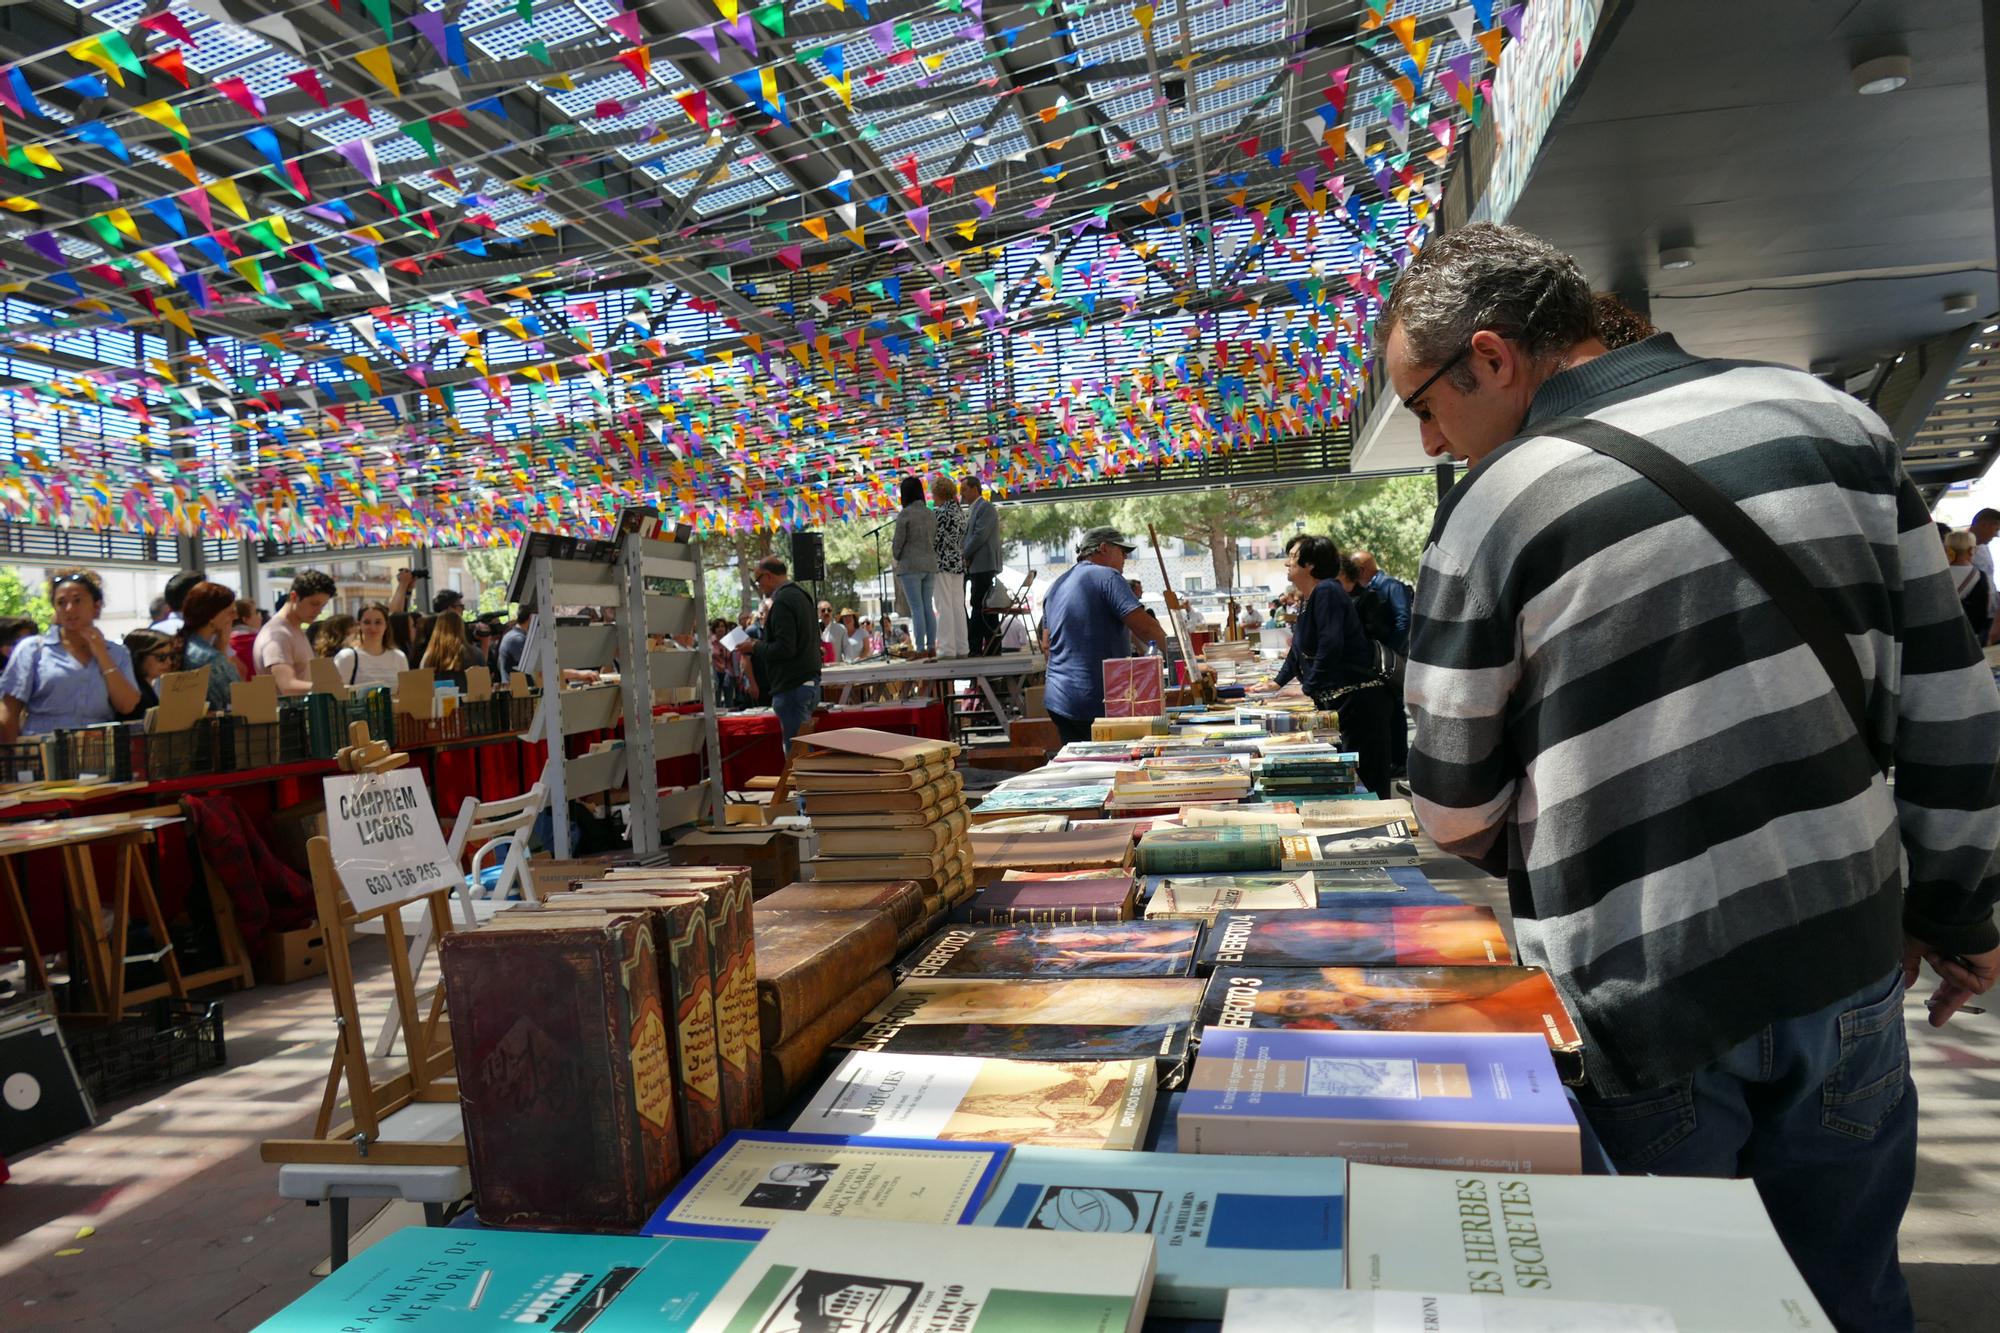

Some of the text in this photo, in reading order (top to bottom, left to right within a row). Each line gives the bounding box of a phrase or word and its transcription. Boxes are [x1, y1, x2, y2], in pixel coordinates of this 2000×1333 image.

[340, 786, 417, 820] COMPREM
[357, 813, 414, 845] LICORS
[366, 861, 441, 895] 630 156 265
[910, 930, 977, 977] EVERFOTO 2
[1215, 921, 1254, 962] EVERFOTO
[1218, 977, 1263, 1028] ERFOTO 3
[859, 1070, 906, 1120] ARBÚCIES
[1120, 1063, 1149, 1127] DIPUTACIÓ DE GIRONA
[1455, 1178, 1505, 1296] ES HERBES
[1497, 1181, 1553, 1290] SECRETES
[341, 1260, 450, 1333] RAGMENTS
[444, 1240, 477, 1255] DE
[394, 1259, 488, 1323] MEMÒRIA
[499, 1291, 535, 1320] FULLS
[512, 1272, 594, 1324] DIETARI
[1422, 1296, 1440, 1333] ERONI
